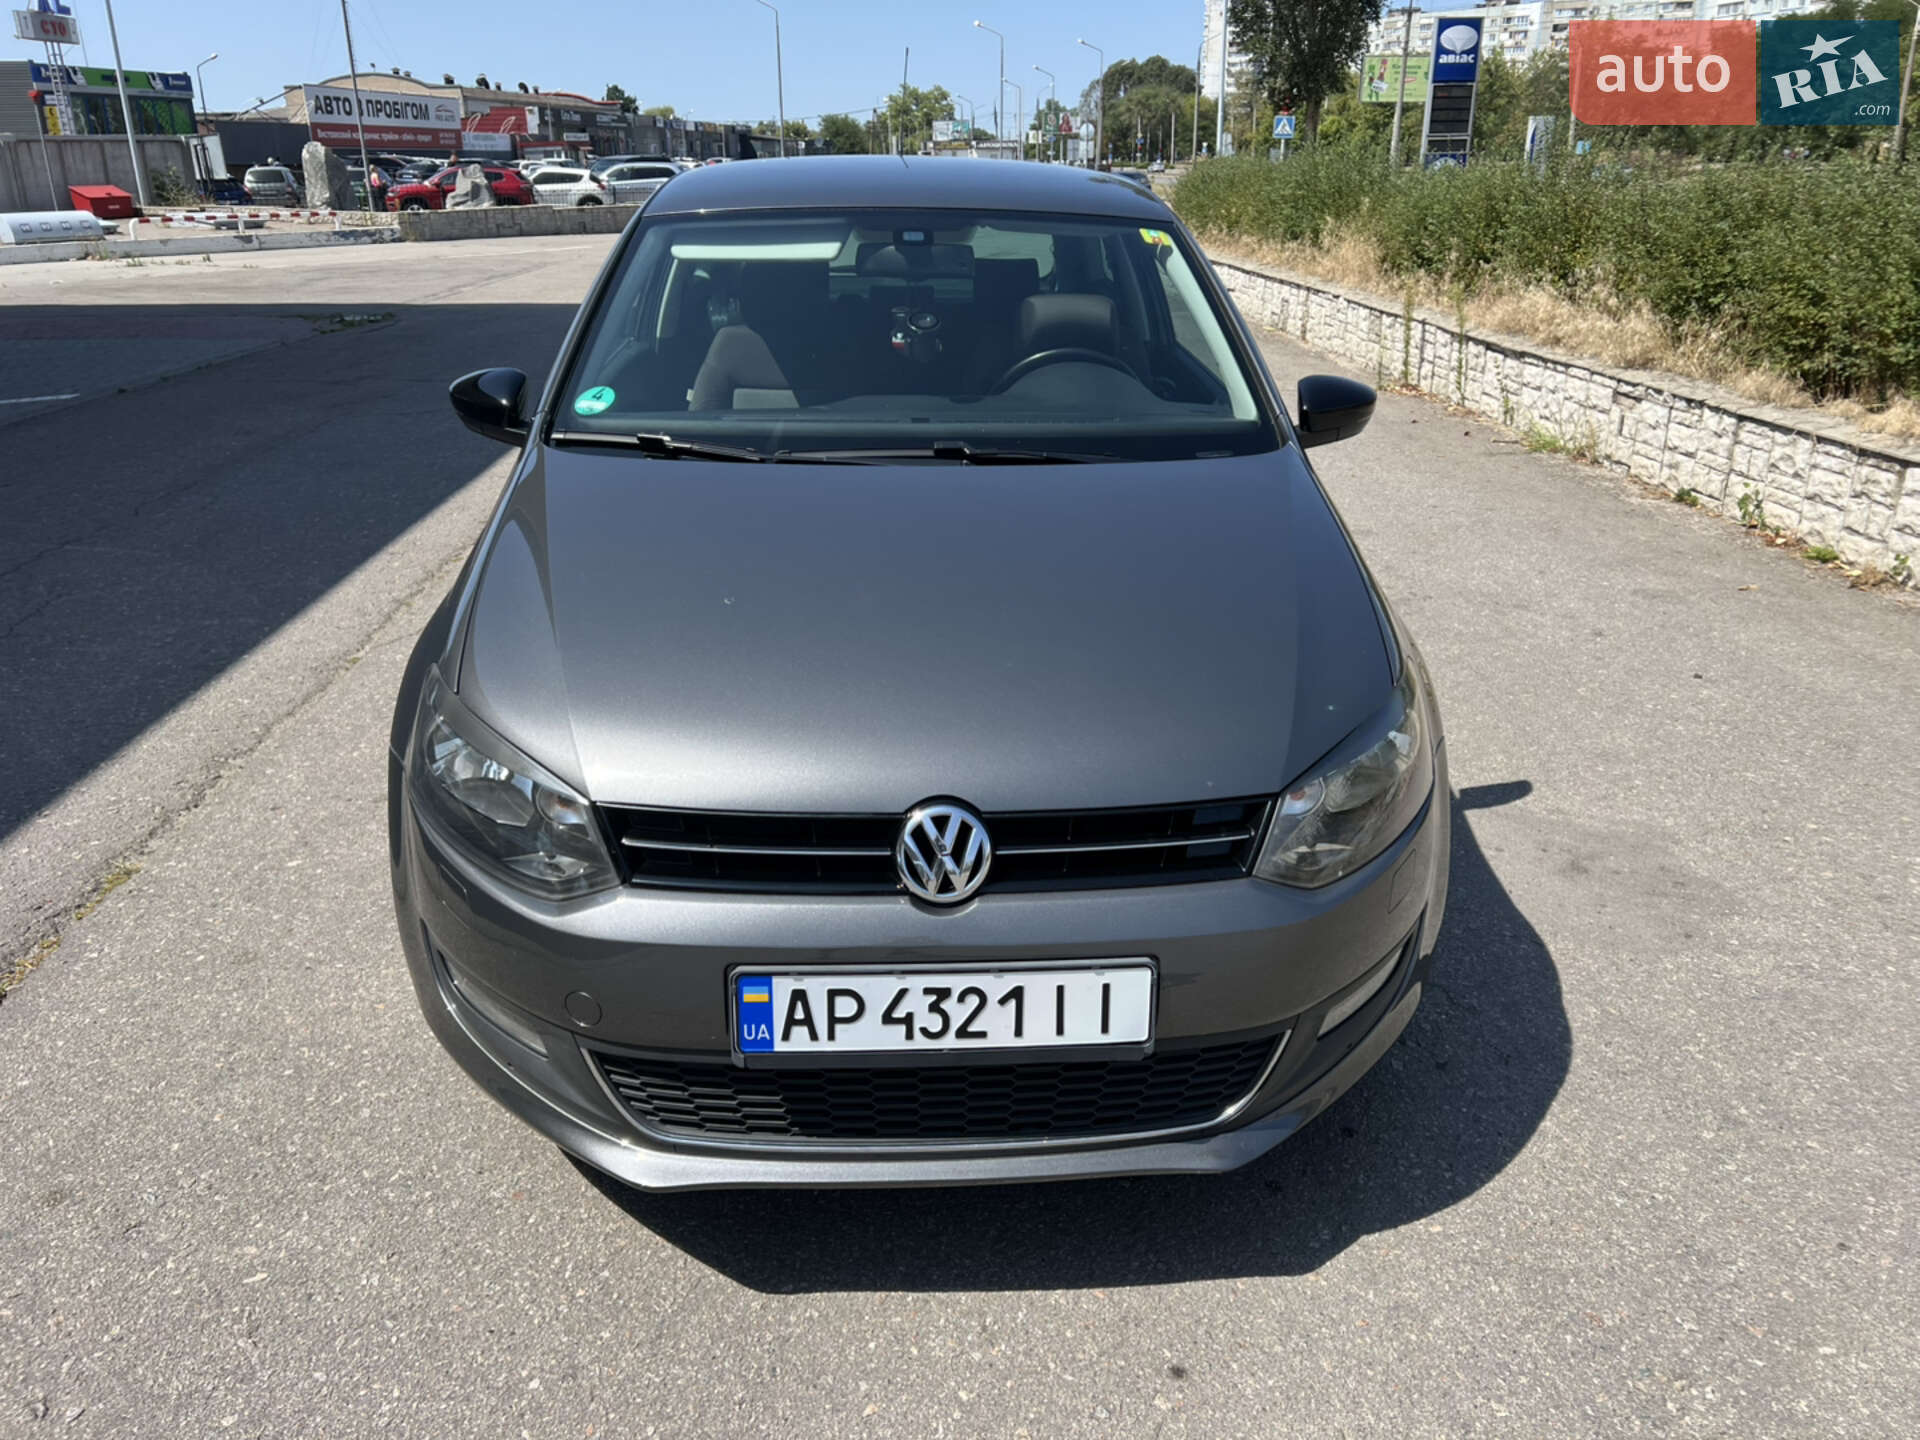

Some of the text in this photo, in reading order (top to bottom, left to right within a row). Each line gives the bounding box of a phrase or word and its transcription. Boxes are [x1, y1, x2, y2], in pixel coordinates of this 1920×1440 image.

[314, 94, 353, 116] АВТО
[366, 98, 431, 121] ПРОБІГОМ
[591, 387, 606, 400] 4
[780, 987, 866, 1042] AP
[881, 985, 1024, 1041] 4321
[743, 1023, 771, 1041] UA
